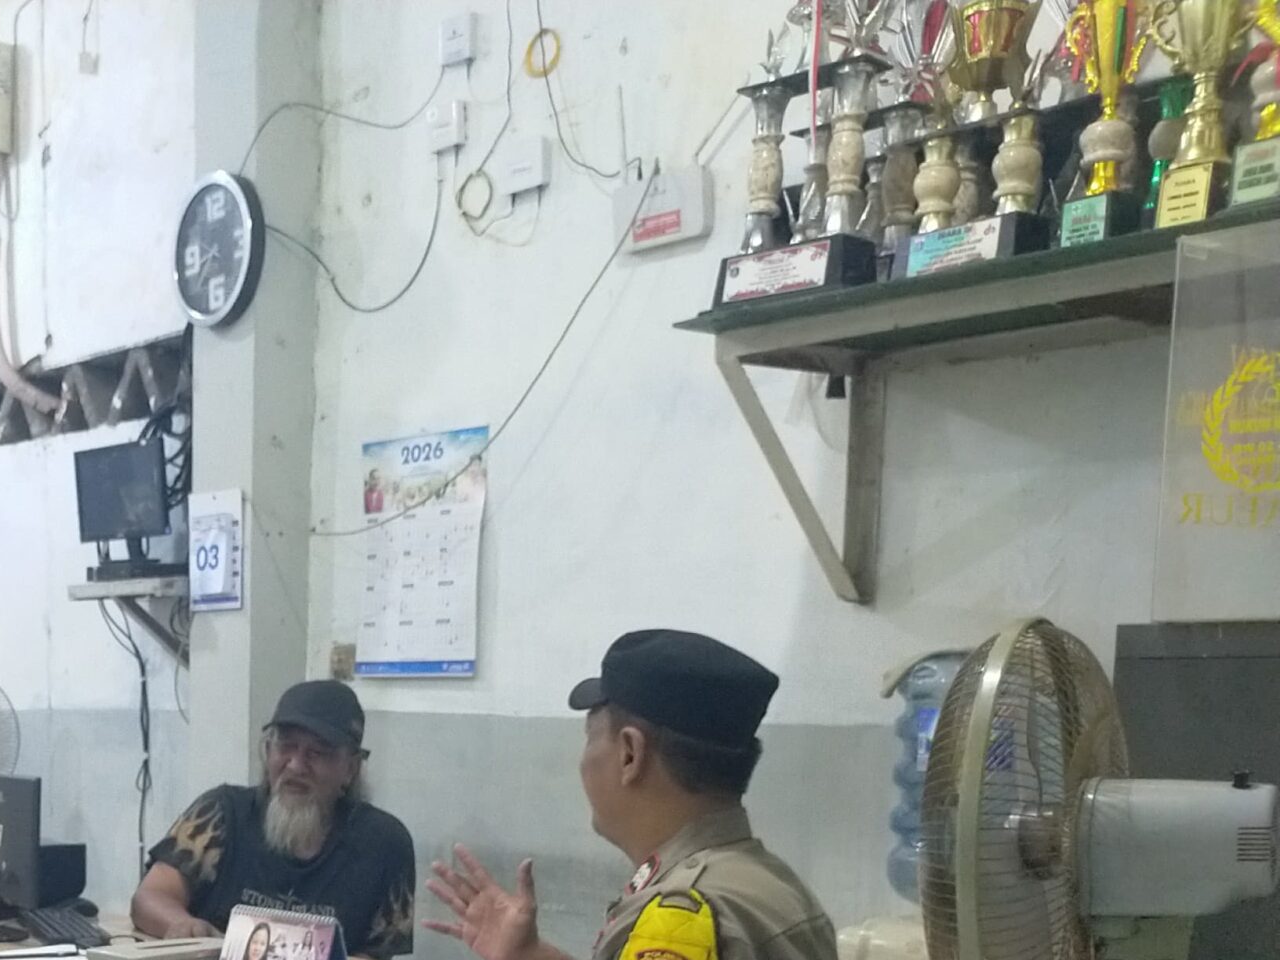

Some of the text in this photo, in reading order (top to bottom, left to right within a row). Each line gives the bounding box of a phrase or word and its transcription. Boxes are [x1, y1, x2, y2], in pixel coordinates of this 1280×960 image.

[205, 190, 226, 222] 12
[184, 245, 200, 277] 9
[208, 273, 226, 311] 6
[401, 441, 444, 465] 2026
[196, 543, 220, 571] 03
